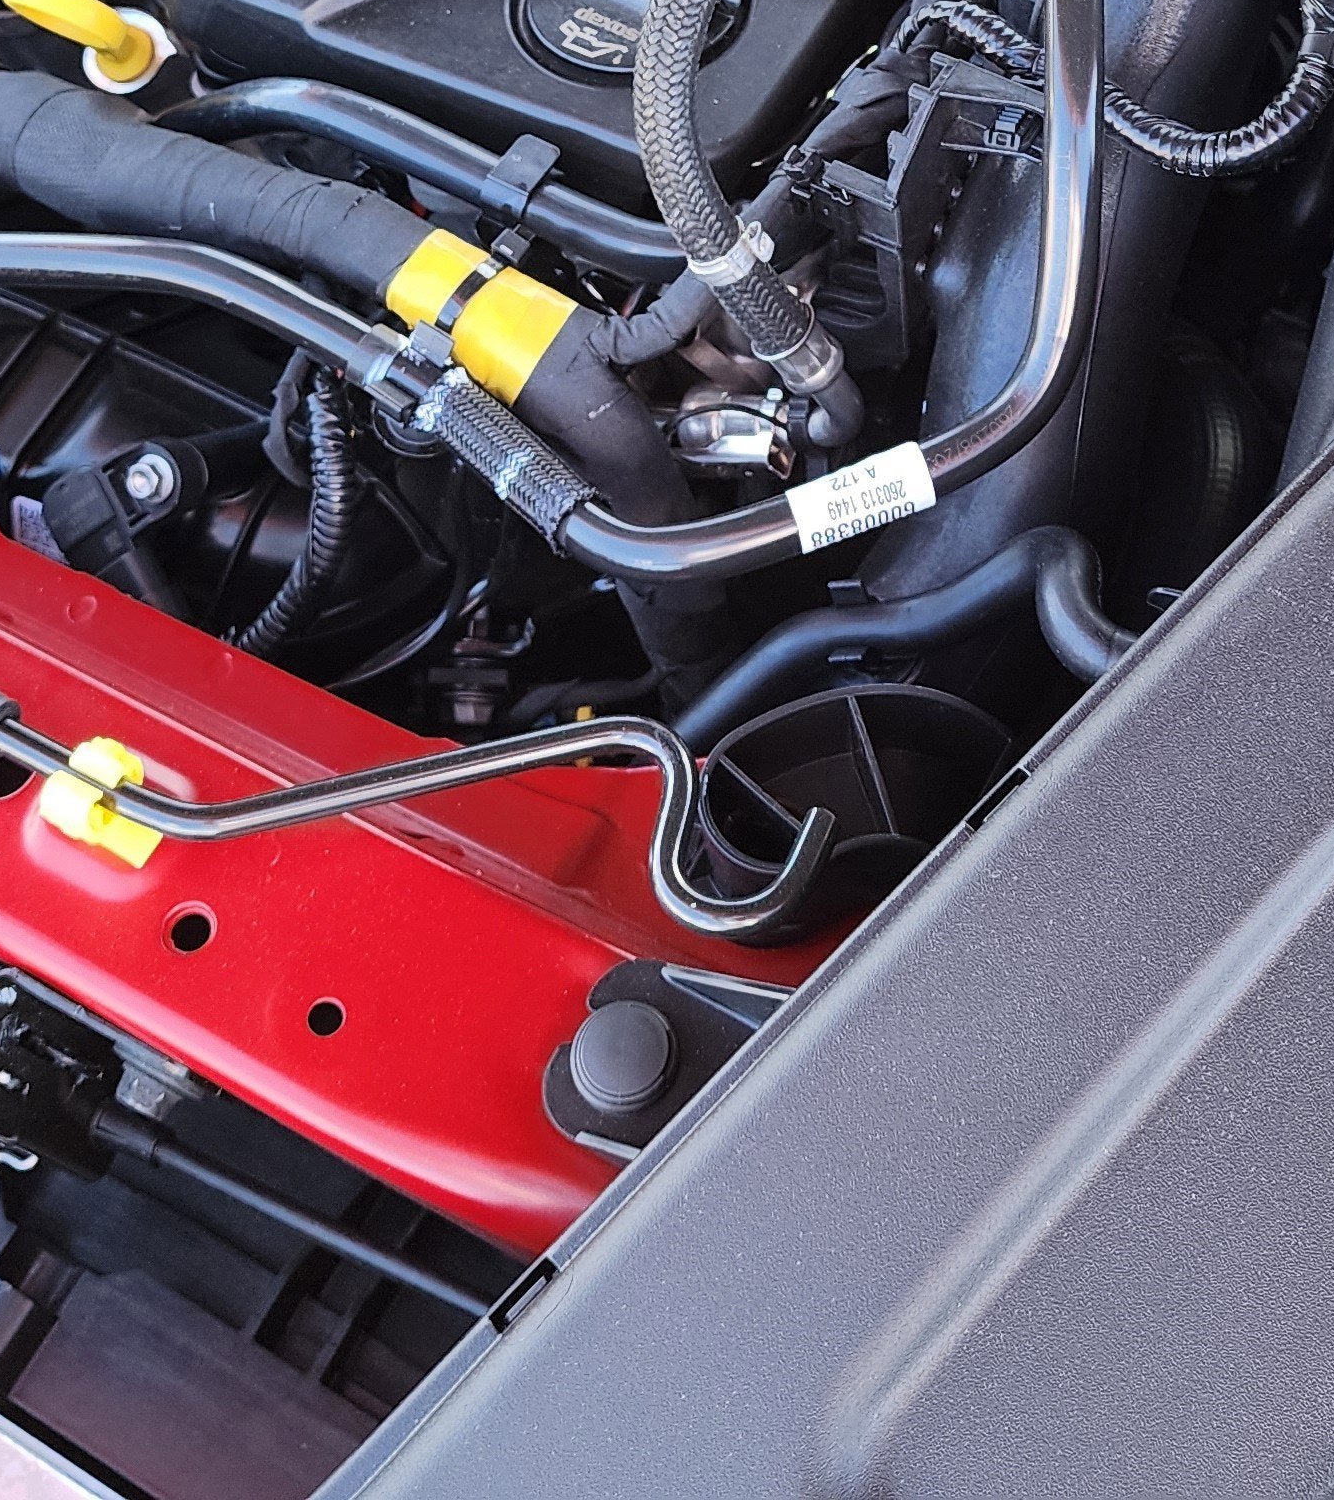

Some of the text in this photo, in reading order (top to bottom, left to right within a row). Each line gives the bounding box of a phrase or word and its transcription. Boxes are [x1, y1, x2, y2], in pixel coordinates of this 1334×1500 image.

[572, 7, 641, 42] dexos
[828, 464, 877, 491] A 172
[827, 479, 907, 521] 260313 1449
